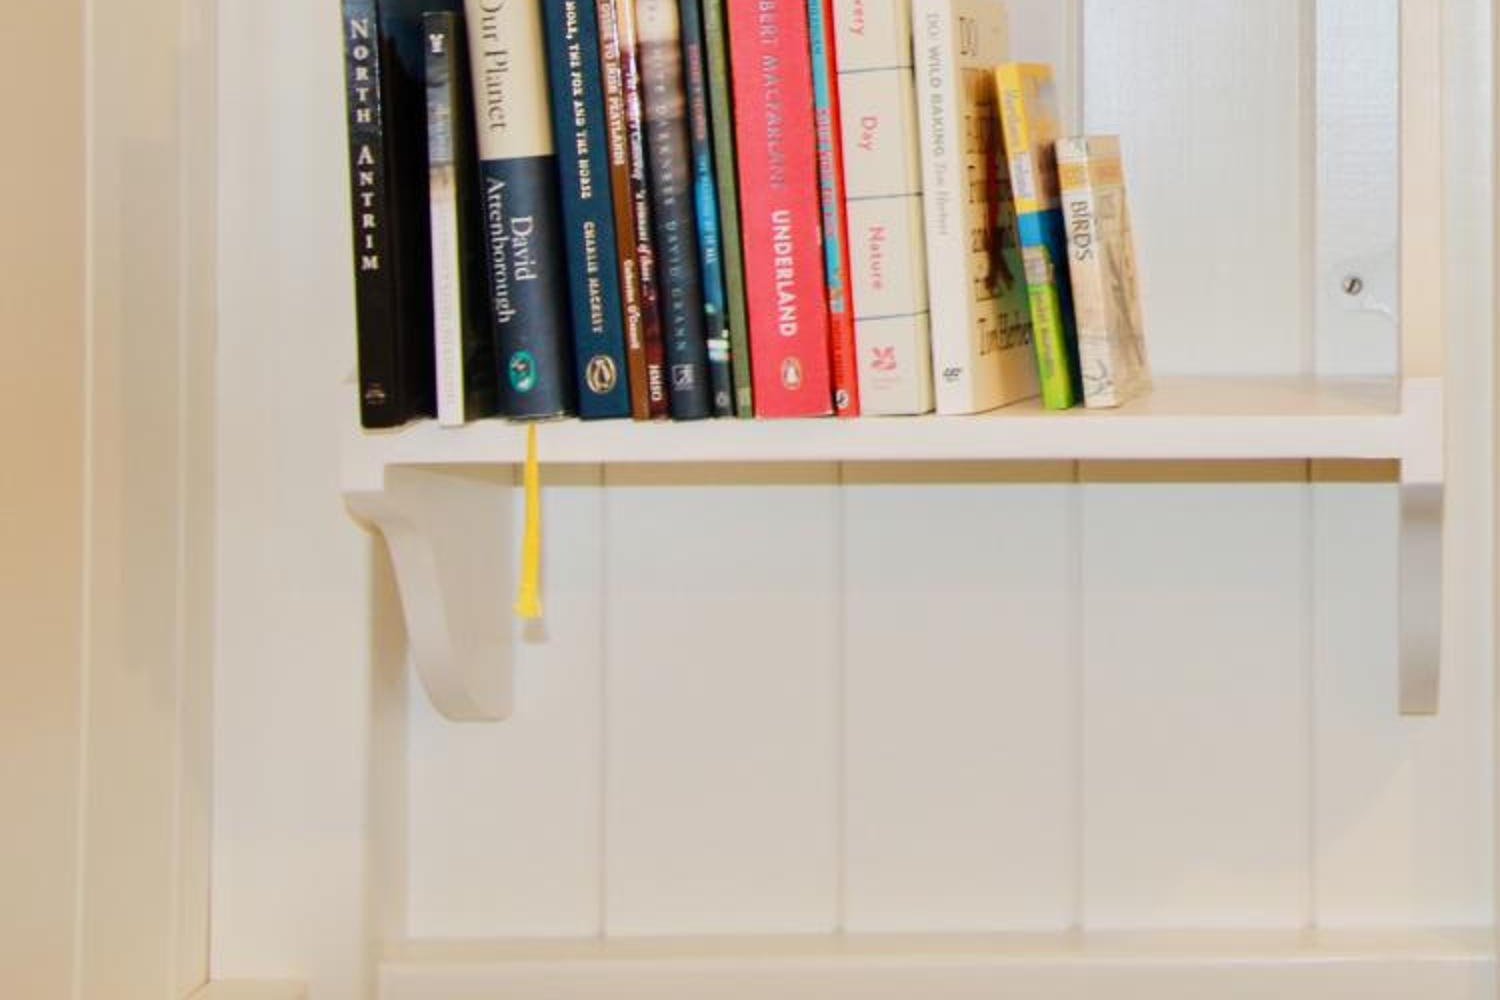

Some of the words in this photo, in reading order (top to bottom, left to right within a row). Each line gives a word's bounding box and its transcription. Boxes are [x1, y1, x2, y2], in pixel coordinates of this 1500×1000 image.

[565, 1, 578, 40] MOLE,
[351, 18, 373, 124] NORTH
[569, 43, 581, 68] THE
[604, 44, 617, 60] TO
[928, 45, 945, 88] WILD
[484, 49, 511, 132] Planet
[571, 72, 583, 97] FOX
[573, 99, 586, 127] AND
[576, 131, 588, 155] THE
[761, 55, 786, 189] MACFARLANE
[857, 115, 879, 151] Day
[930, 93, 947, 158] BAKING
[579, 158, 593, 199] HORSE
[356, 145, 380, 271] ANTRIM
[1070, 200, 1095, 262] BIRDS
[485, 176, 516, 324] Attenborough
[510, 215, 538, 281] David
[584, 221, 601, 272] CHARLIE
[665, 220, 683, 278] DAVID
[771, 209, 798, 337] UNDERLAND
[868, 225, 886, 291] Nature
[587, 276, 605, 334] MACKESY
[647, 365, 662, 402] HMSO
